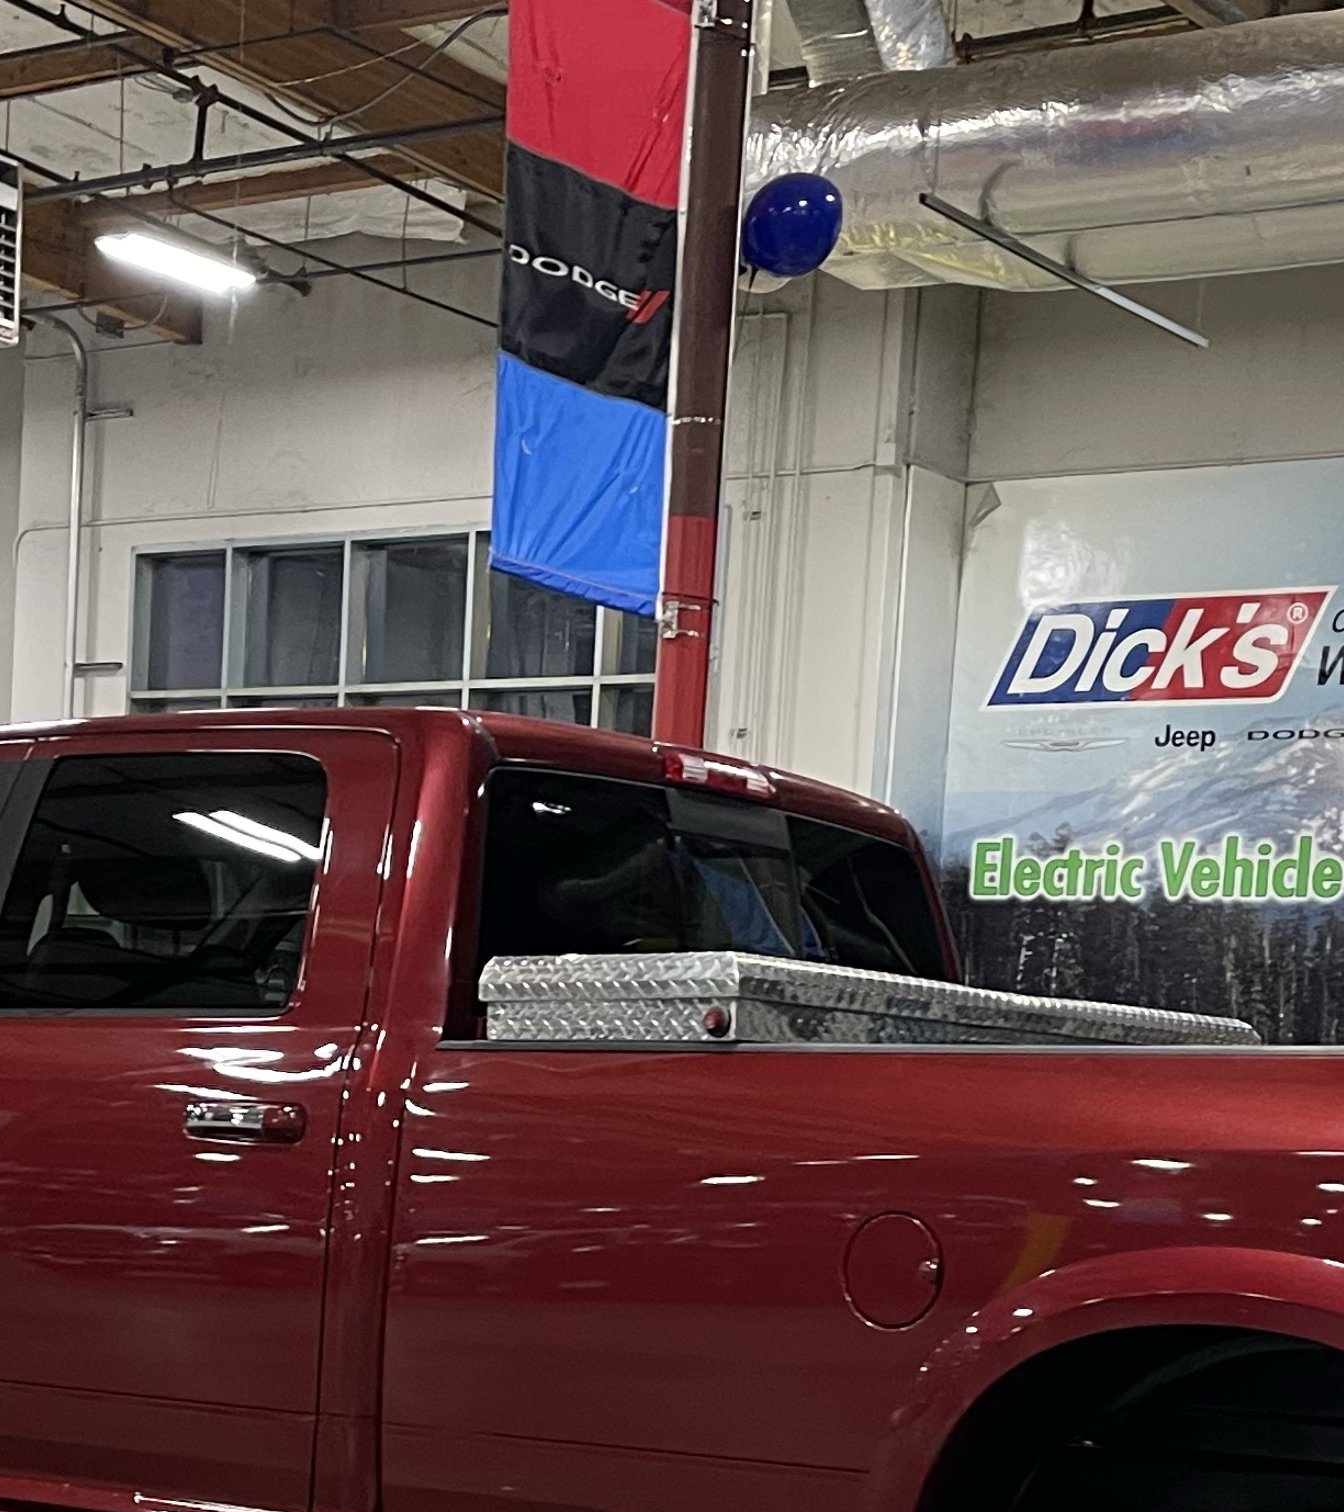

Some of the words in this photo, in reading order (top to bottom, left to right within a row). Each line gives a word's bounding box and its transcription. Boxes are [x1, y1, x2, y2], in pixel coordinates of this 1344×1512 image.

[508, 244, 641, 311] DODGE
[1006, 602, 1289, 695] Dick's
[1154, 724, 1216, 751] Jeep
[971, 837, 1144, 897] Electric
[1161, 835, 1343, 898] Vehicle
